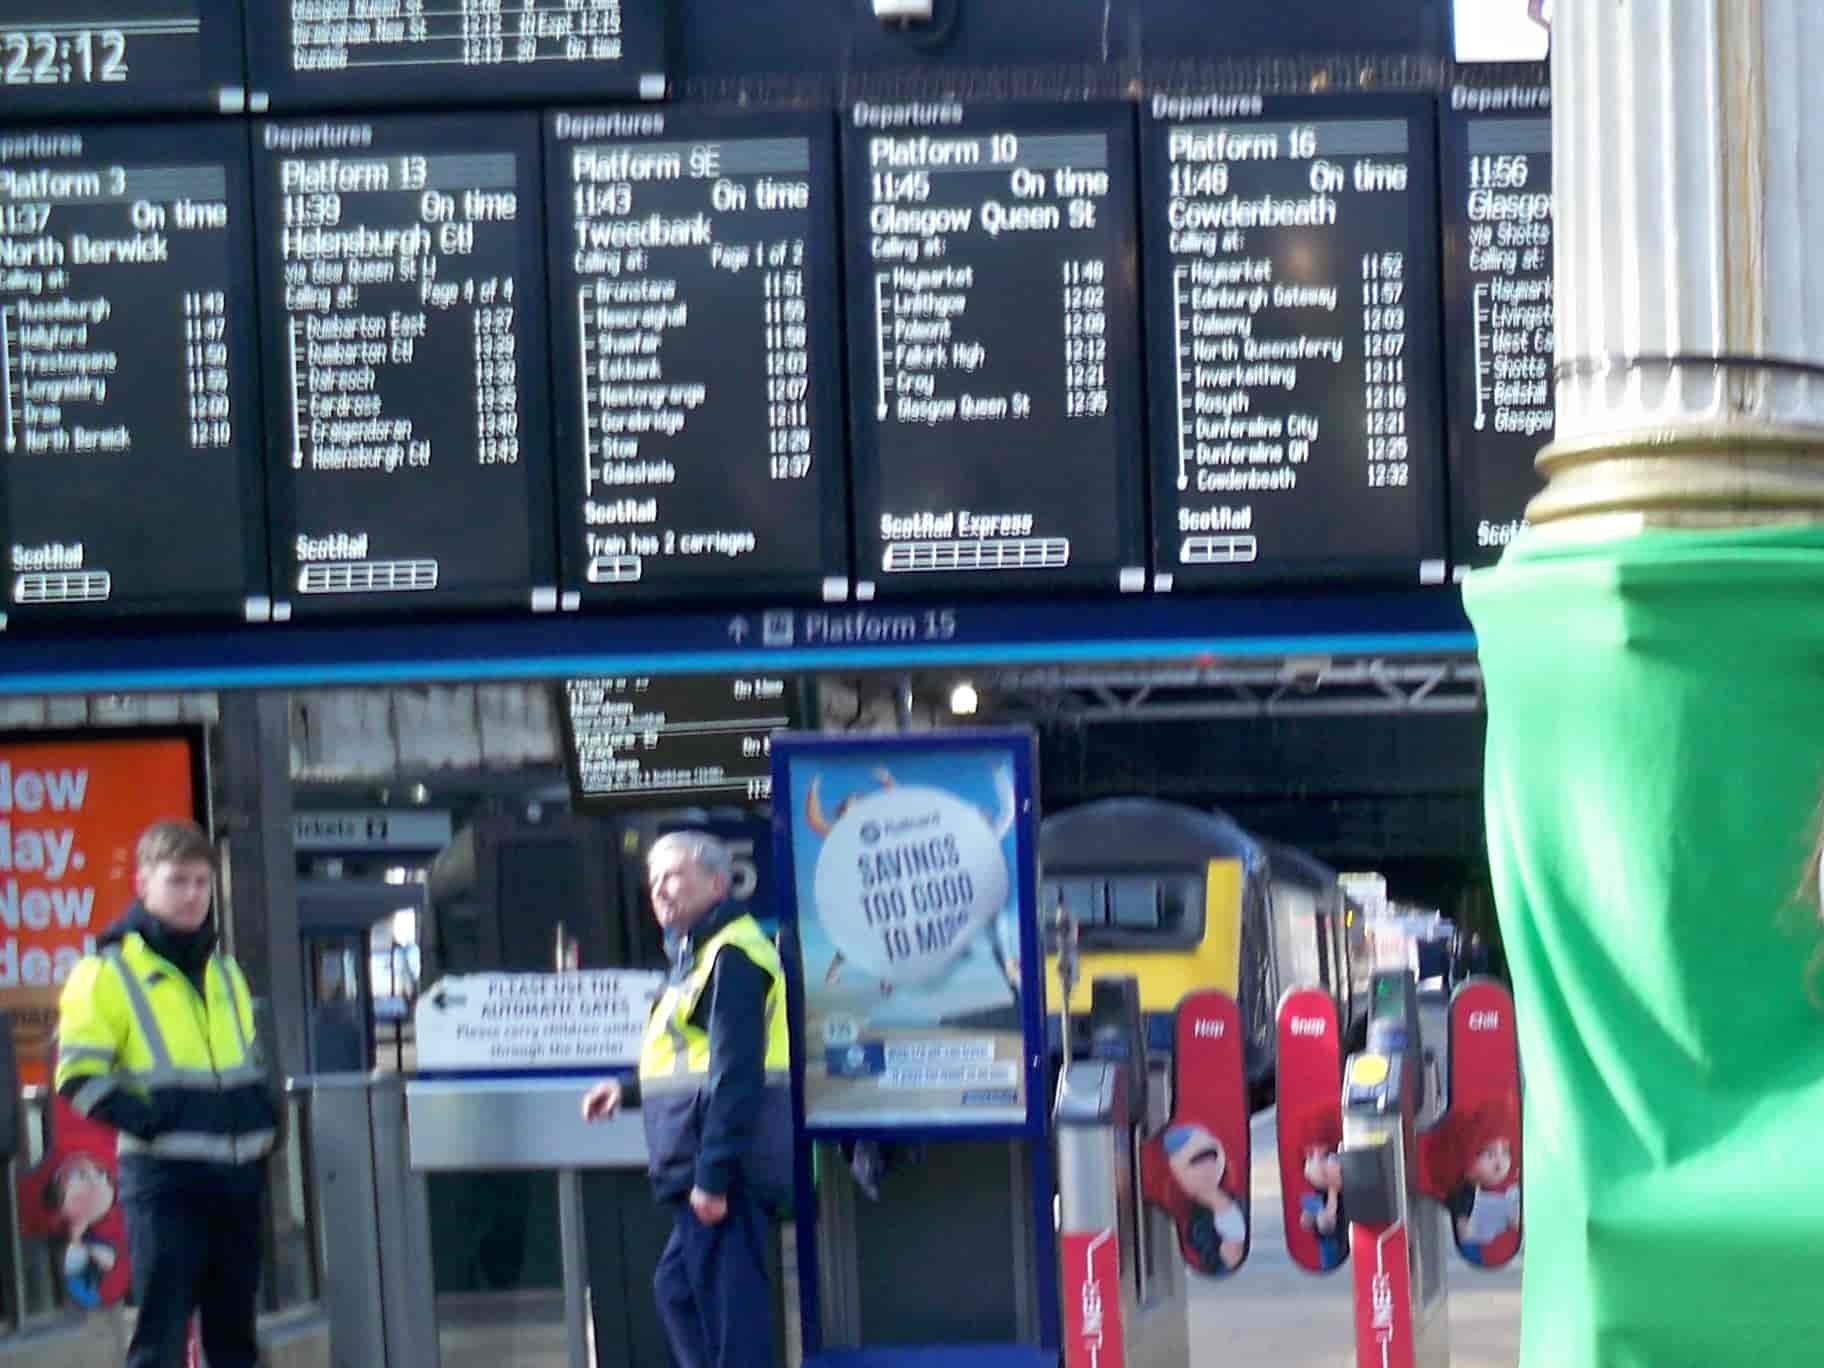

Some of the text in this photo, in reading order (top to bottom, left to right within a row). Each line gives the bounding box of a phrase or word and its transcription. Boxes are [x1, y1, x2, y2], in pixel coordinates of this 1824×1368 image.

[1152, 94, 1264, 121] Departures
[1451, 84, 1551, 112] Departure
[555, 112, 666, 140] Departures
[853, 102, 963, 130] Departures
[264, 123, 373, 150] Departures
[870, 133, 1018, 168] Platform 10
[1168, 122, 1317, 164] Platform 16
[281, 155, 428, 193] Platform 13
[573, 143, 722, 183] Platform 9E
[1309, 158, 1345, 193] On
[1353, 158, 1409, 193] time
[1469, 153, 1528, 188] 11:56
[109, 165, 127, 196] 3
[872, 166, 1110, 203] 11:45 On time
[284, 187, 519, 227] 11:39 On time
[574, 176, 810, 217] 11:43 On time
[1467, 189, 1553, 224] Glasgo
[132, 200, 165, 230] On
[173, 198, 228, 230] time
[870, 198, 1097, 240] Glasgow Queen St
[1168, 194, 1337, 231] Cowdenbeath
[282, 222, 432, 260] Helensburgh
[574, 210, 714, 251] Tweedbank
[1469, 221, 1551, 248] via Shotts
[0, 232, 169, 266] North Berwick
[1469, 246, 1518, 275] Calling
[892, 265, 973, 294] Haymarket
[1191, 257, 1272, 288] Haymarket
[420, 278, 460, 310] Page
[1192, 284, 1337, 315] Edinburgh Gateway
[307, 311, 427, 341] Dumbarton East
[307, 341, 387, 367] Dumbarton
[1194, 335, 1343, 363] North Queensferry
[1195, 363, 1297, 391] Inverkeithing
[1365, 358, 1403, 384] 12:11
[1494, 355, 1546, 380] Shotts
[897, 393, 1008, 427] Glasgow Queen
[1195, 389, 1249, 417] Rosyth
[310, 417, 413, 447] Craigendoran
[1286, 413, 1319, 442] City
[1495, 406, 1553, 437] Glasgow
[312, 440, 405, 473] Helensburgh
[1198, 466, 1297, 493] Cowdenbeath
[585, 498, 658, 525] ScotRail
[880, 511, 1034, 543] ScotRail Express
[1178, 506, 1252, 532] ScotRail
[296, 533, 369, 561] ScotRail
[630, 529, 756, 558] has 2 carriages
[806, 608, 916, 643] Platform
[858, 831, 961, 888] SAVINGS
[864, 869, 974, 928] TOO GOOD
[884, 925, 912, 963] TO
[488, 976, 546, 997] PLEASE
[592, 975, 620, 995] THE
[481, 999, 631, 1019] AUTOMATIC GATES
[456, 1021, 500, 1041] Please
[543, 1019, 602, 1039] children
